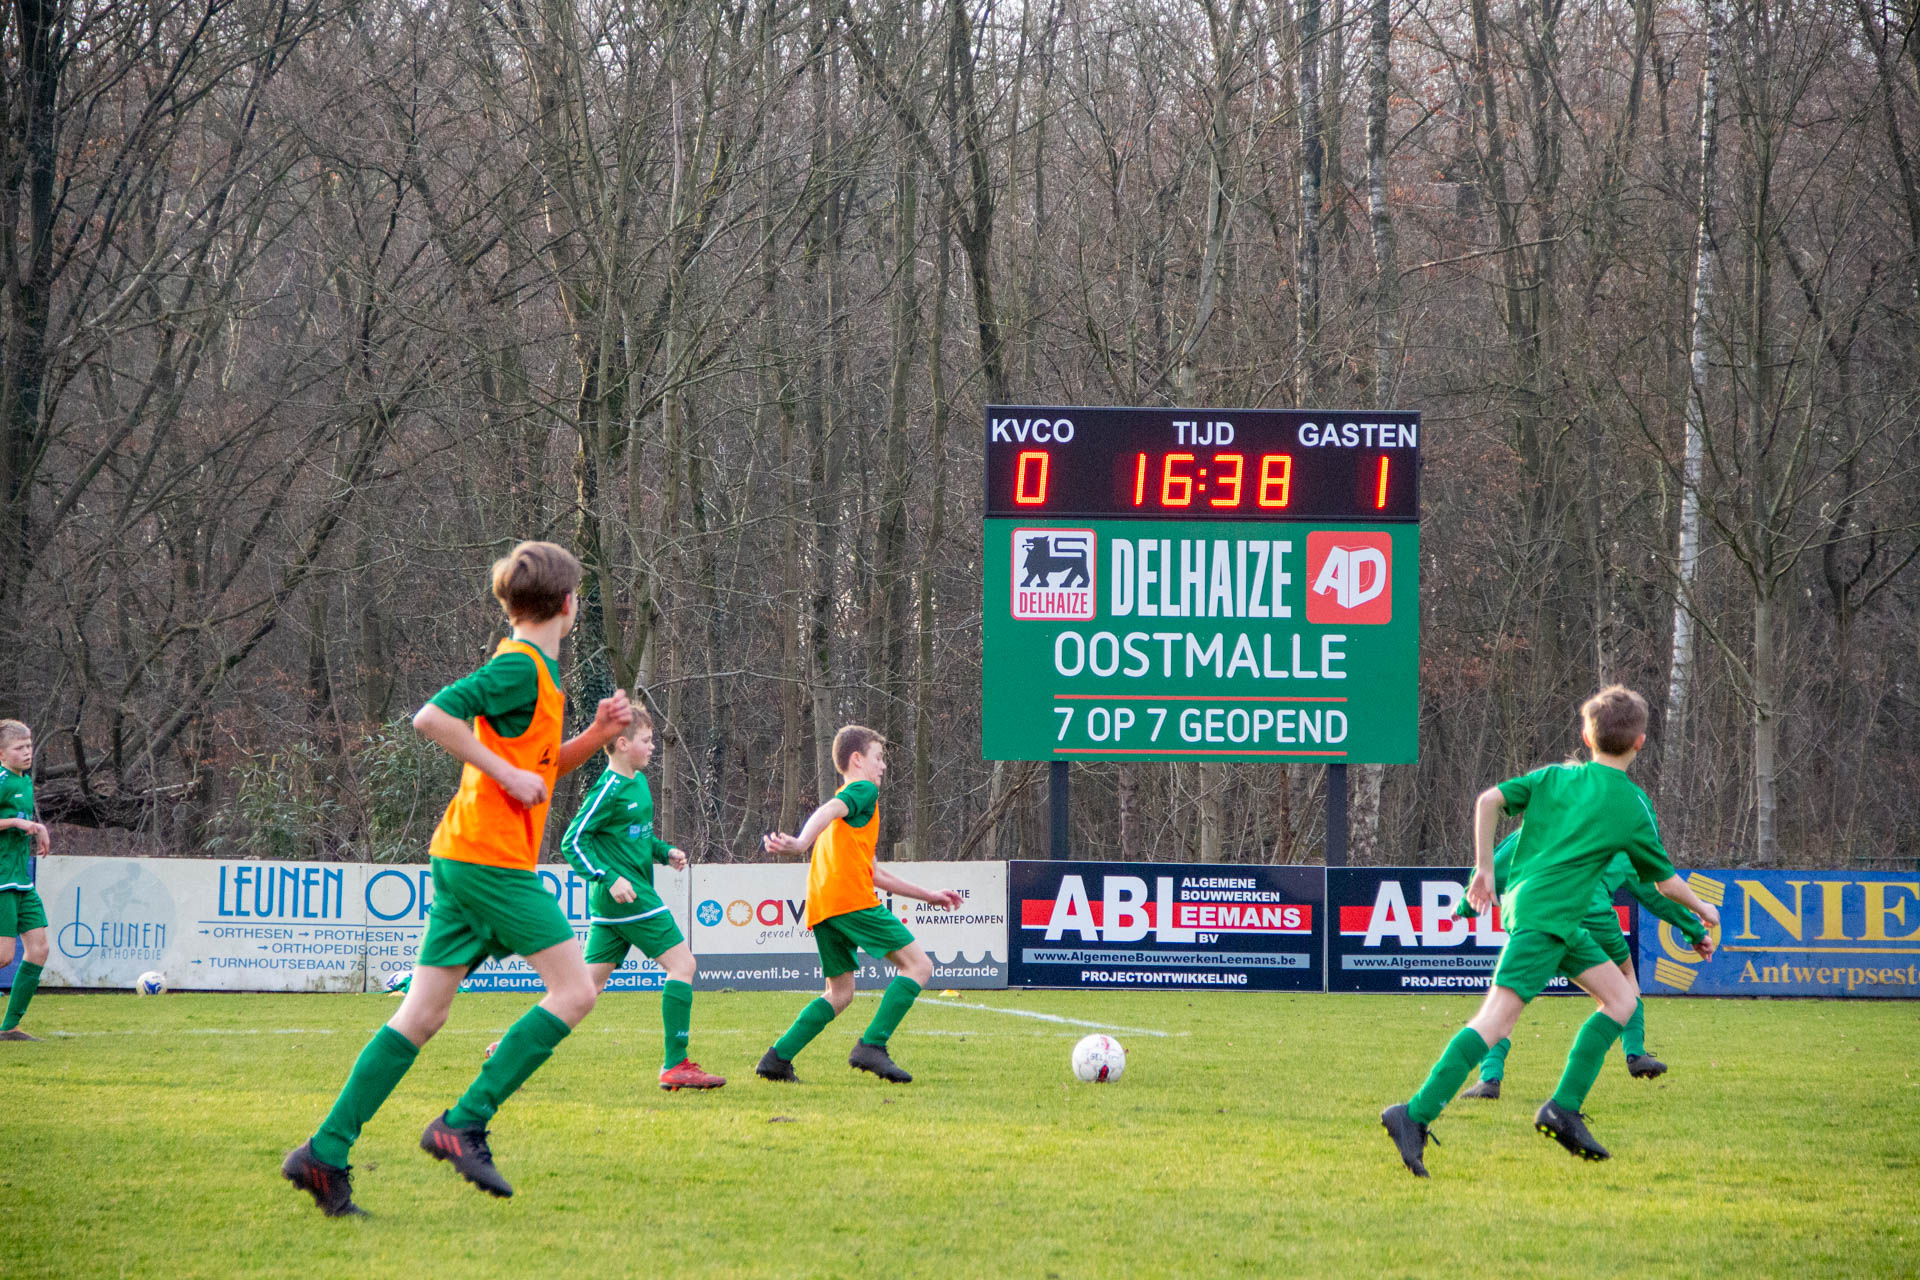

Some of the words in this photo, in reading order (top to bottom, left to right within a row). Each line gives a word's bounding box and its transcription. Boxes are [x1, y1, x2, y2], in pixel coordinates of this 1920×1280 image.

[992, 418, 1075, 443] KVCO
[1173, 421, 1235, 446] TIJD
[1298, 423, 1417, 448] GASTEN
[1015, 451, 1050, 505] 0
[1133, 453, 1292, 508] 16:38
[1375, 455, 1391, 509] 1
[1110, 538, 1293, 619] DELHAIZE
[1312, 545, 1388, 609] AD
[1019, 592, 1089, 615] DELHAIZE
[1054, 630, 1348, 679] OOSTMALLE
[1053, 707, 1075, 741] 7
[1087, 707, 1136, 742] OP
[1146, 708, 1168, 742] 7
[1179, 708, 1348, 744] GEOPEND
[218, 865, 344, 919] LEUNEN
[1181, 876, 1256, 889] ALGEMENE
[1044, 874, 1196, 943] ABL
[1181, 890, 1280, 902] BOUWWERKEN
[915, 914, 1004, 925] WARMTEPOMPEN
[213, 927, 293, 939] ORTHESEN
[314, 929, 404, 942] PROTHESEN
[1199, 934, 1219, 944] BV
[271, 942, 399, 956] ORTHOPEDISCHE
[1034, 952, 1296, 966] www.AlgemeneBouwwerkenLeemans.be
[209, 957, 345, 971] TURNHOUTSEBAAN
[349, 960, 365, 972] 75
[699, 966, 800, 981] www.aventi.be
[1081, 971, 1248, 985] PROJECTONTWIKKELING
